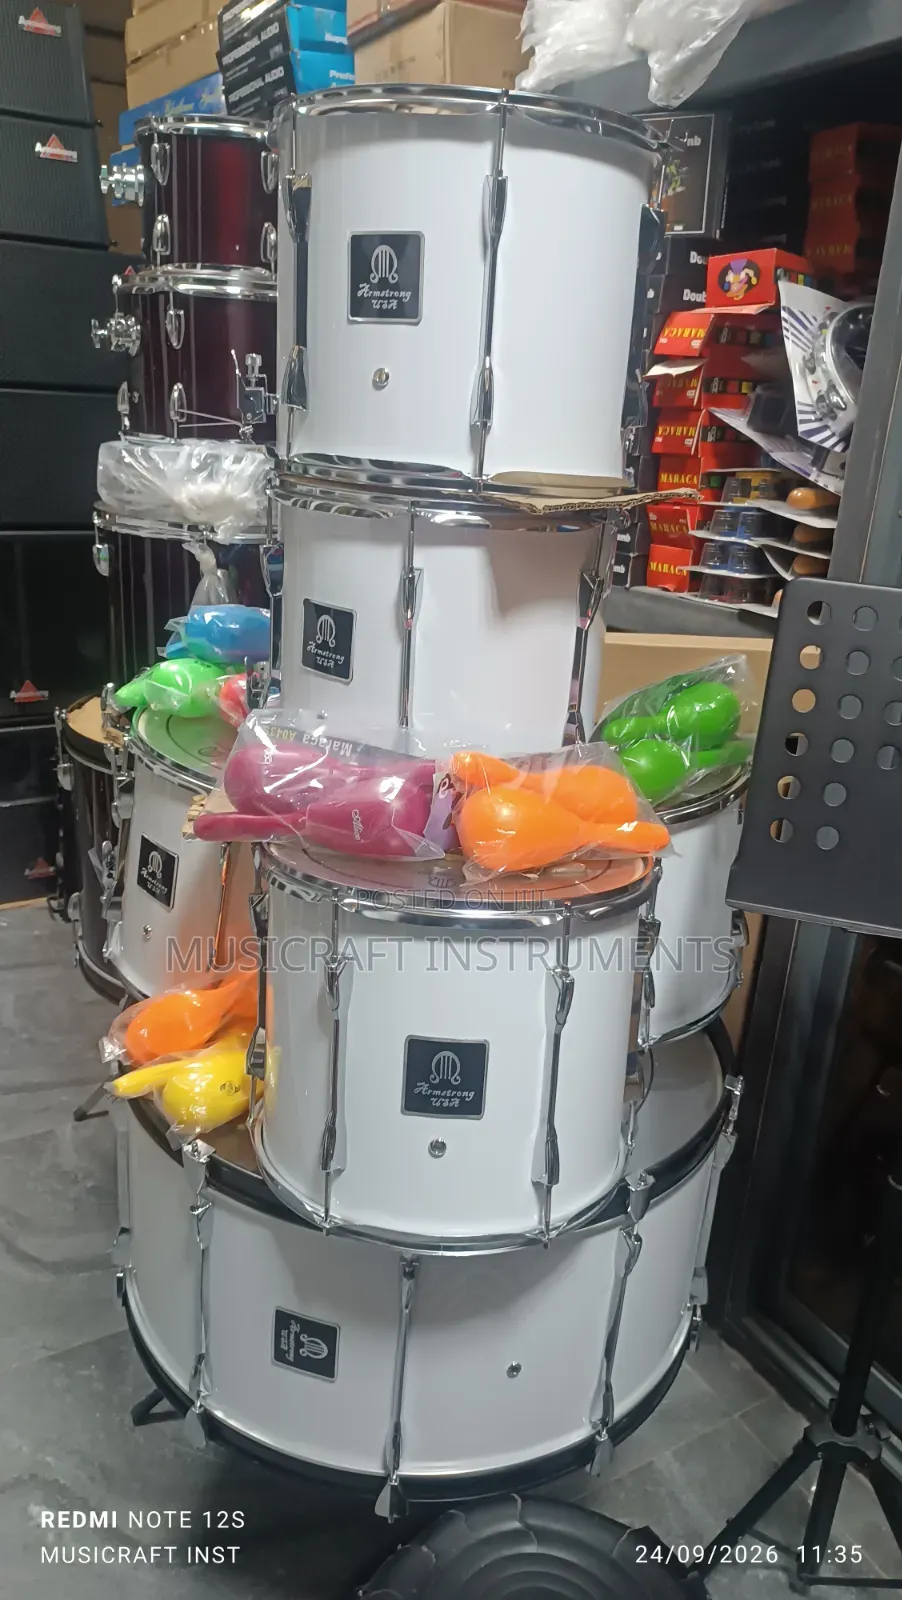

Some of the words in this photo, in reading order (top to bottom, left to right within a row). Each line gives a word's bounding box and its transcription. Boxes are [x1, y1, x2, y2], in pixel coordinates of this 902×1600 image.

[261, 22, 280, 41] AUDIO
[264, 66, 285, 83] AUDIO
[357, 283, 411, 302] Armstrong
[372, 299, 398, 309] USA
[663, 327, 705, 338] MARACA
[658, 426, 697, 437] MARACA
[660, 473, 697, 484] MARACA
[650, 521, 689, 535] MARACA
[649, 562, 687, 576] MARACA
[307, 641, 344, 664] Armstrong
[316, 656, 335, 668] USA
[302, 733, 352, 757] Maraca
[414, 1081, 475, 1101] Armstrong
[430, 1097, 460, 1108] USA
